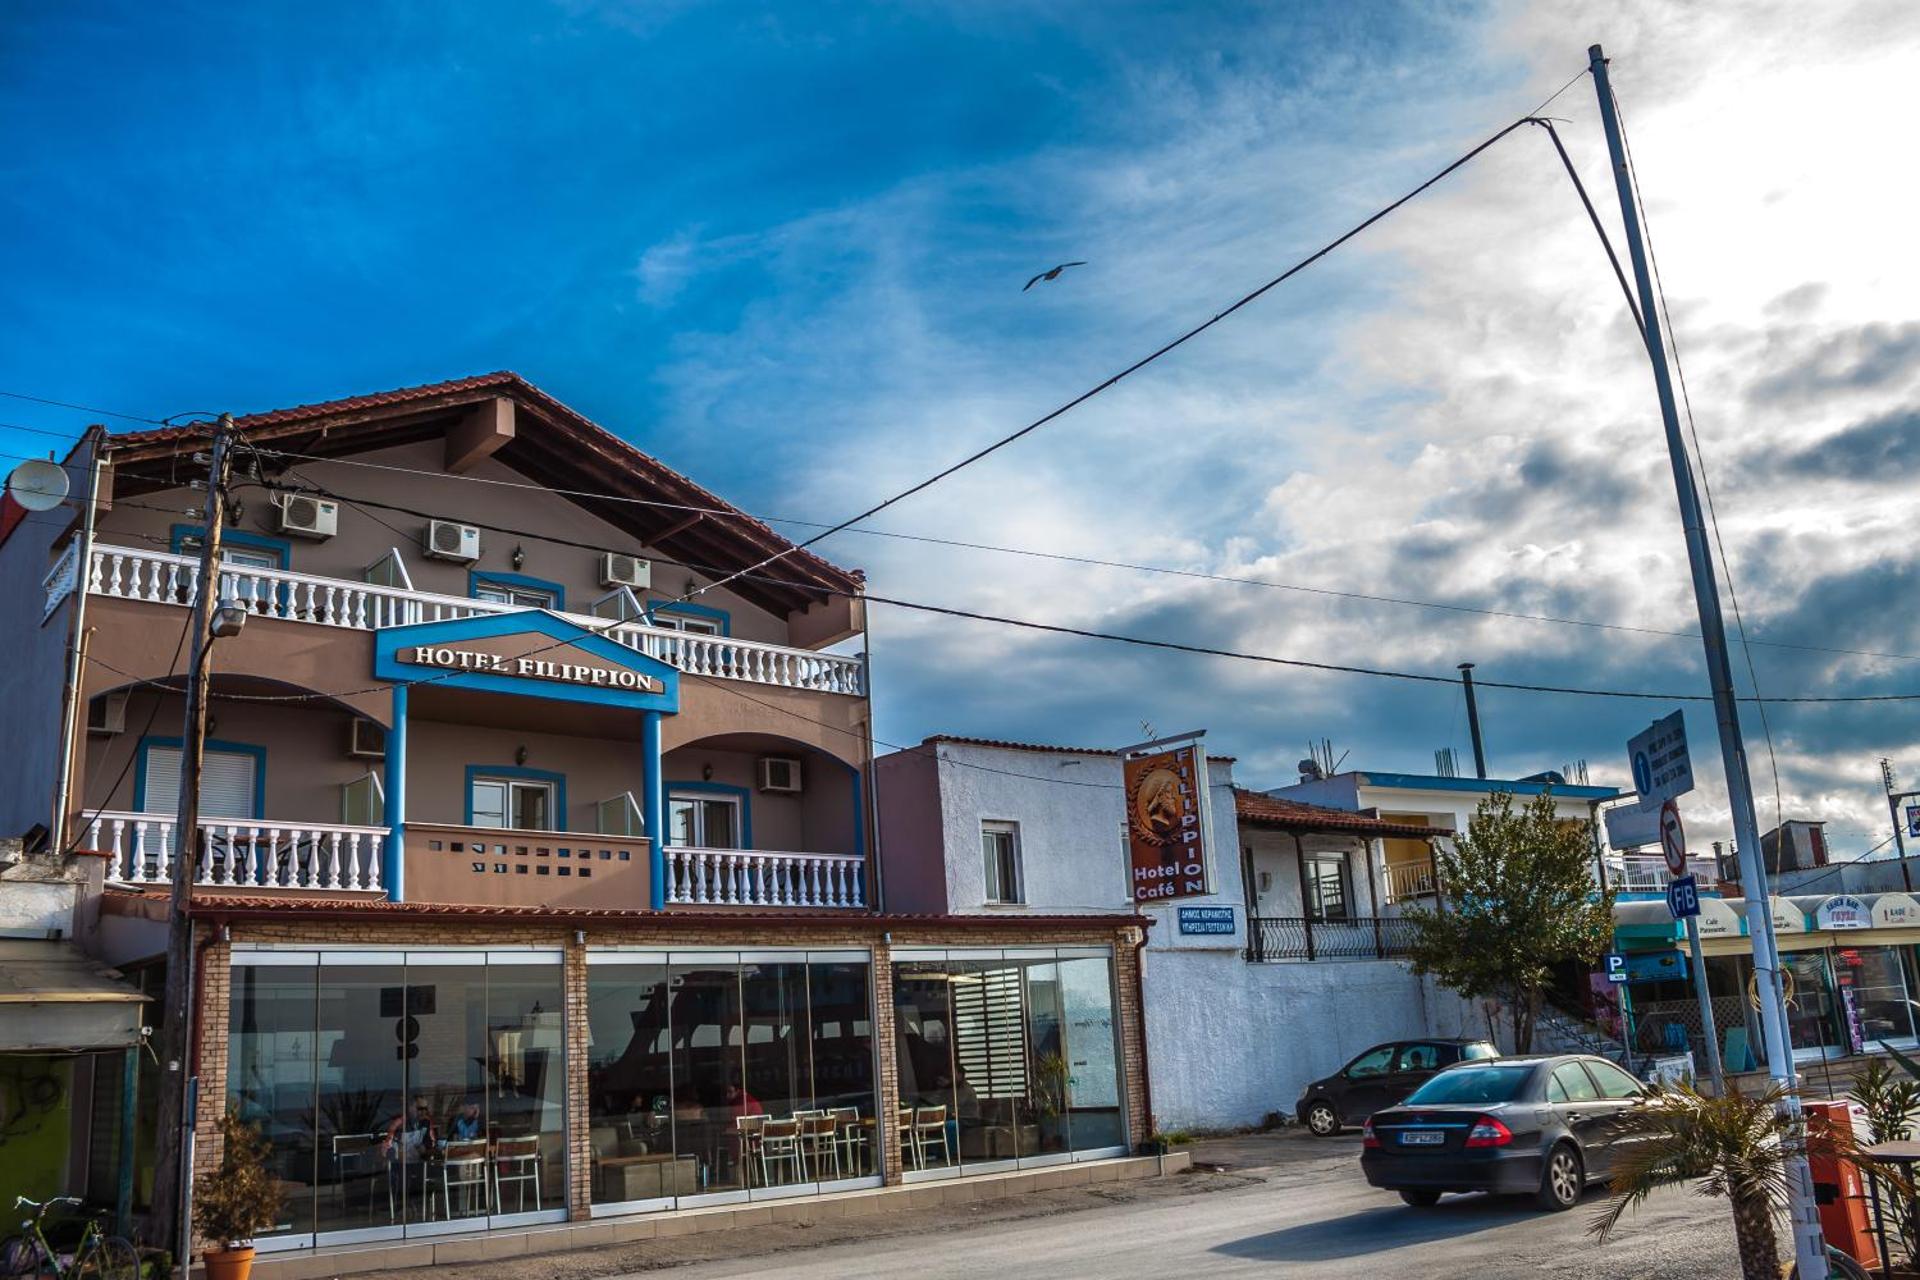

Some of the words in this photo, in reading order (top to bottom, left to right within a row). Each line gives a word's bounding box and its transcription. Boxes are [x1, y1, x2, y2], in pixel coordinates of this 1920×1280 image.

[415, 647, 509, 672] HOTEL
[518, 658, 652, 690] FILIPPION
[1177, 751, 1203, 893] FILIPPION
[1134, 861, 1180, 881] Hotel
[1136, 880, 1176, 900] Café
[1610, 957, 1623, 972] P
